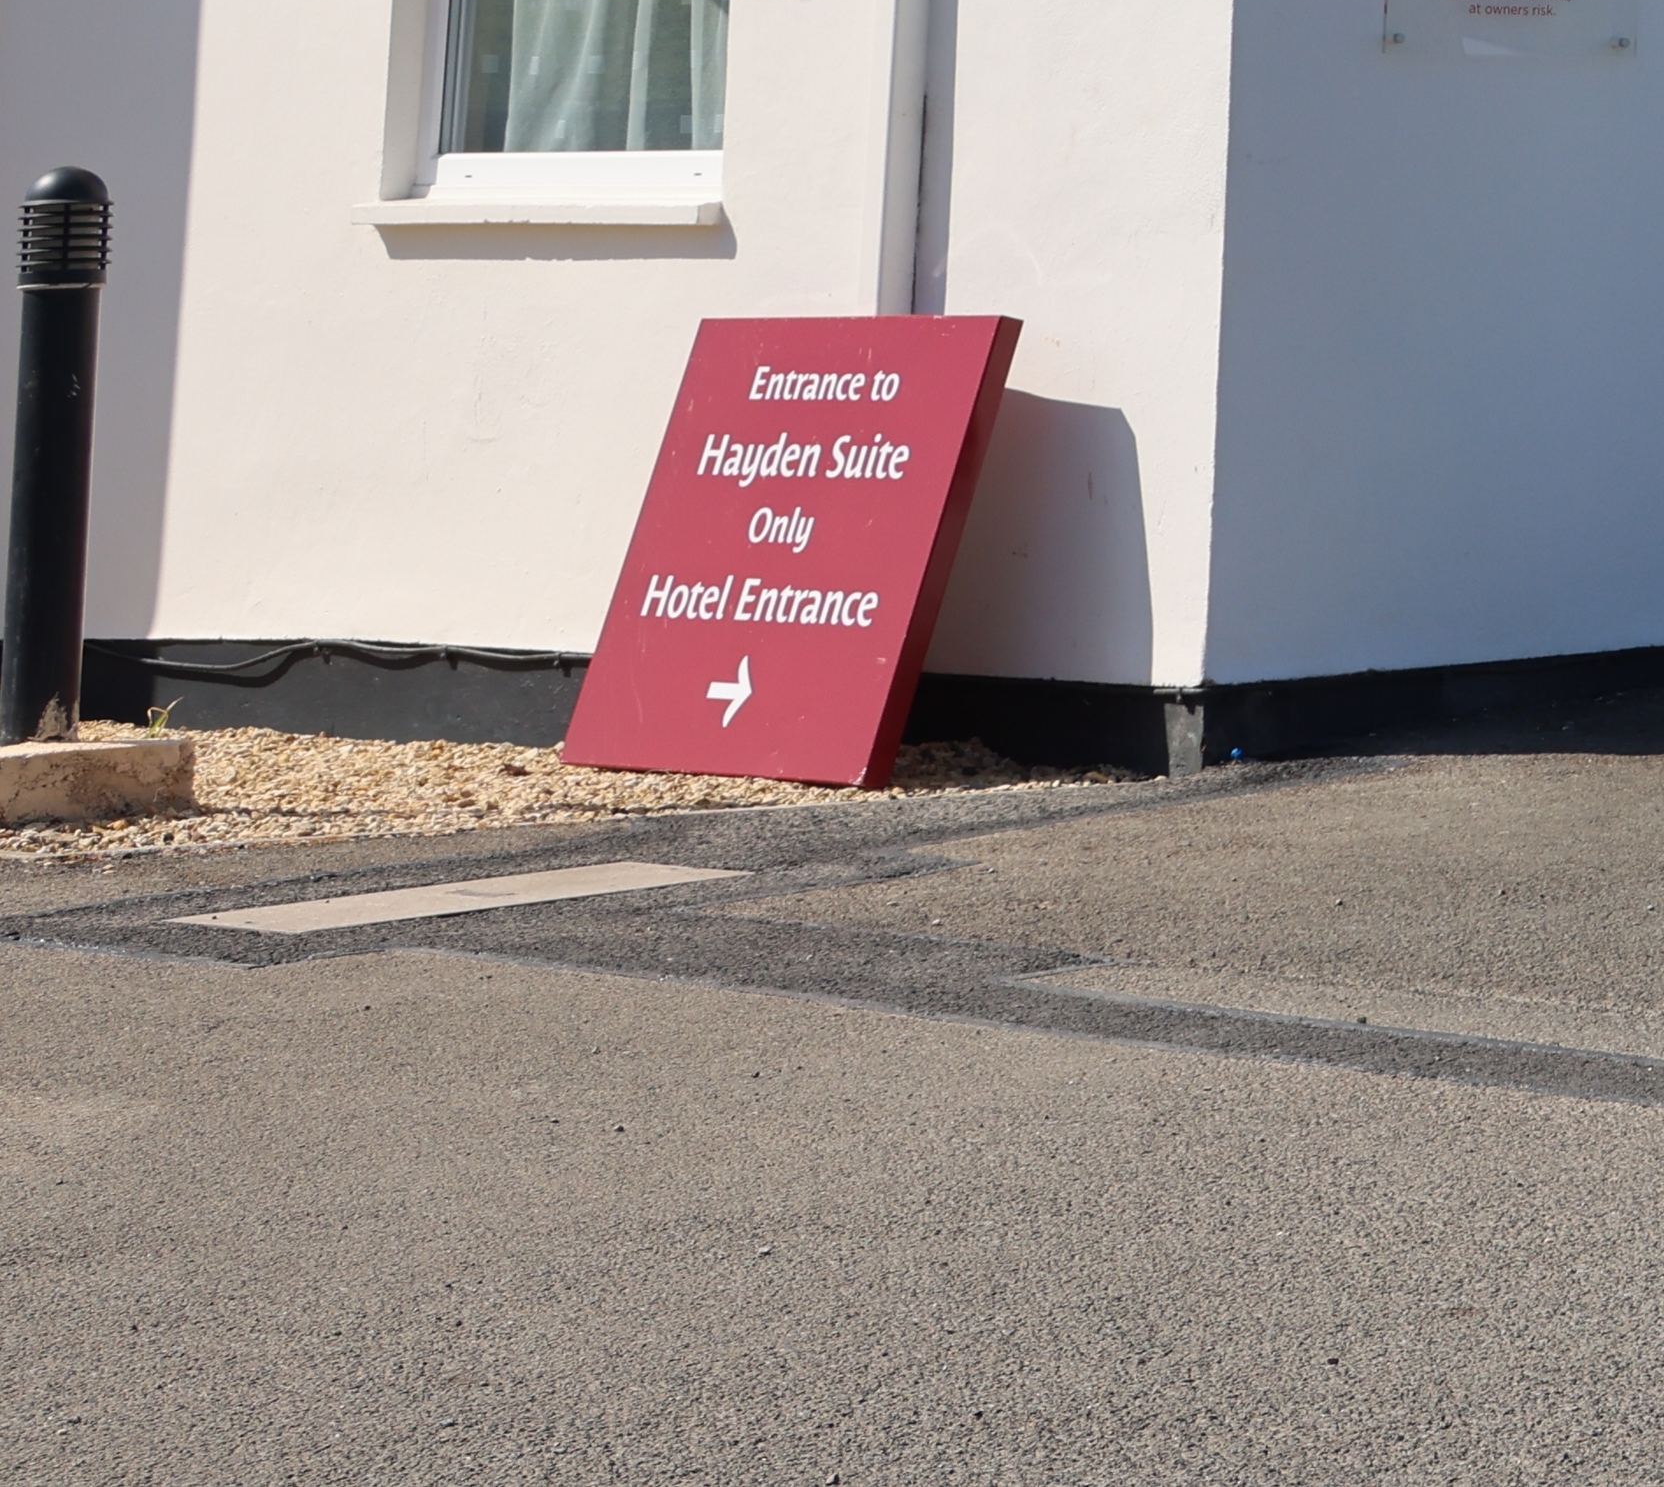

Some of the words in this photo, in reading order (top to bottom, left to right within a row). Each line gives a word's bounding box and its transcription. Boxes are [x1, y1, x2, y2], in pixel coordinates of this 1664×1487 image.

[1469, 4, 1481, 15] at
[1485, 5, 1528, 16] owners
[1532, 5, 1556, 17] risk.
[748, 365, 866, 402] Entrance
[870, 368, 900, 402] to
[697, 433, 823, 487] Hayden
[826, 434, 911, 480] Suite
[747, 506, 815, 553] Only
[640, 574, 734, 620] Hotel
[733, 577, 879, 627] Entrance
